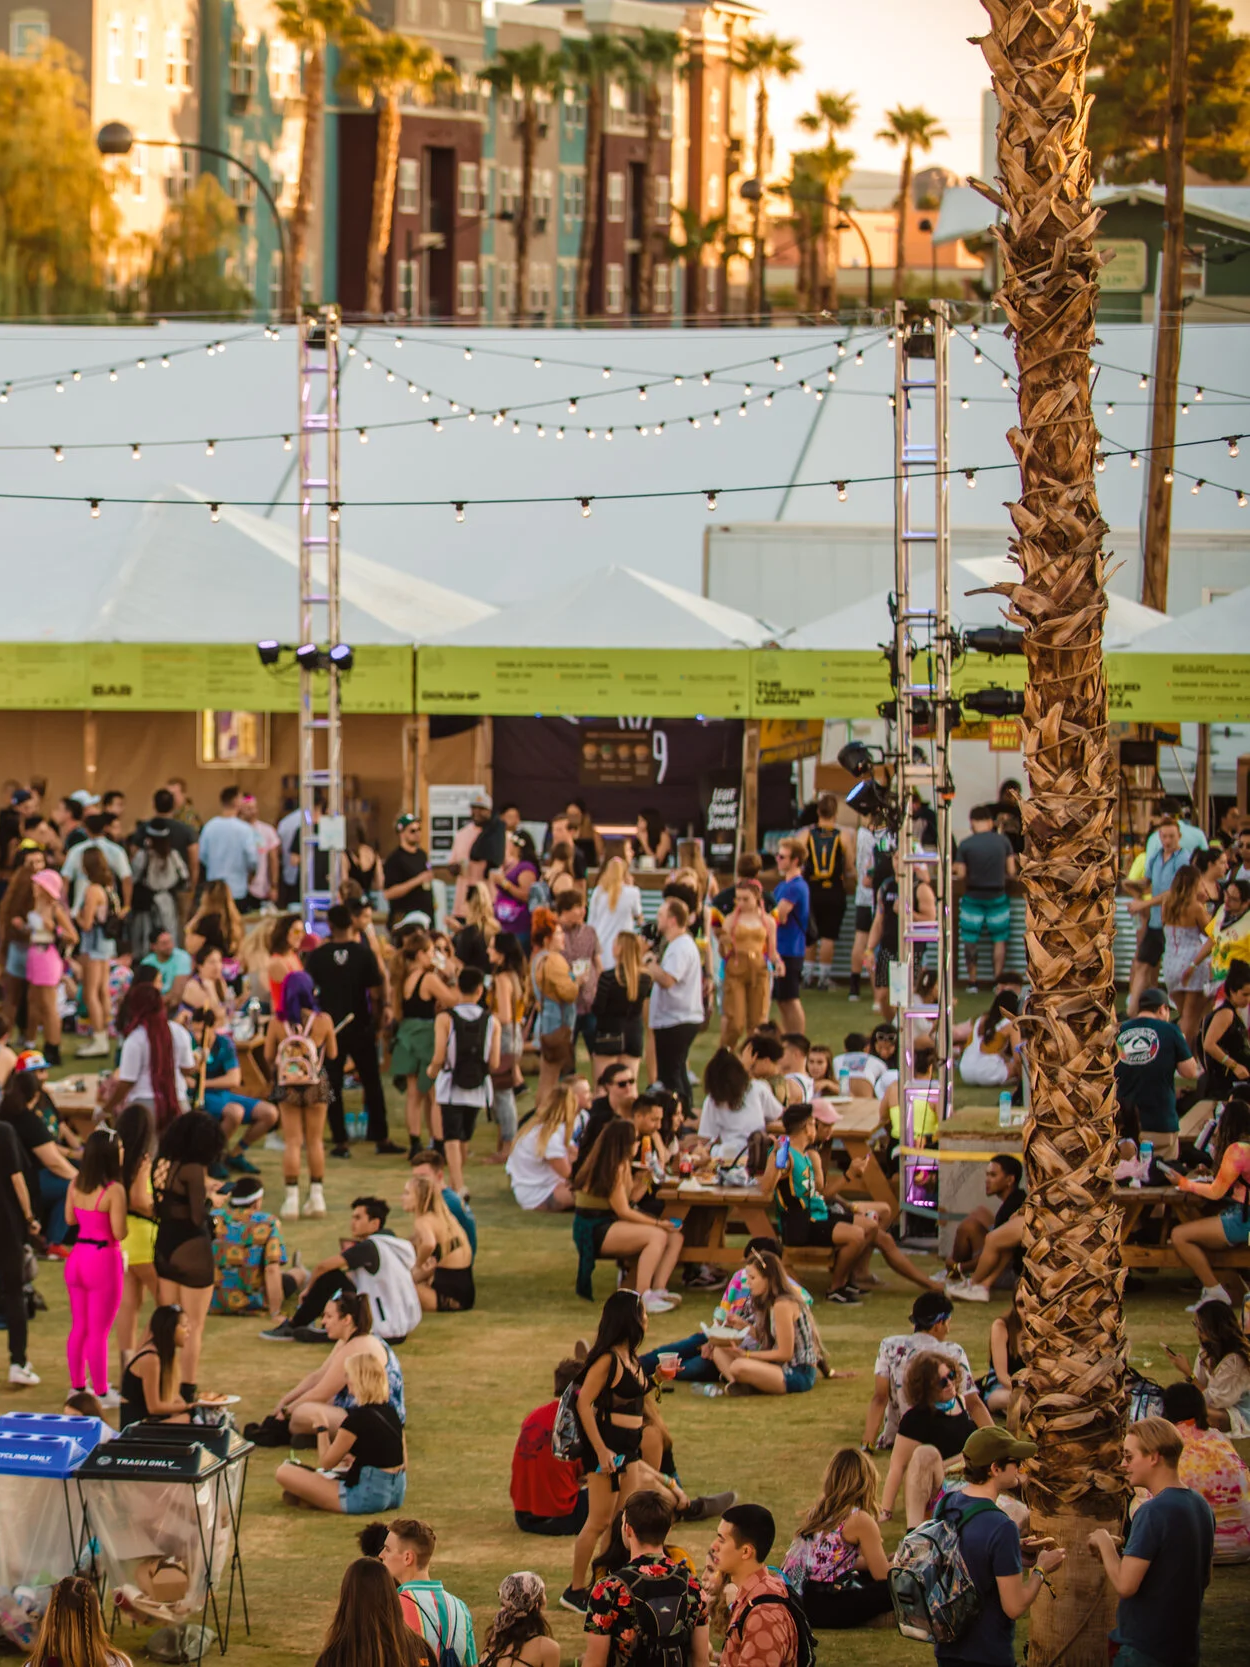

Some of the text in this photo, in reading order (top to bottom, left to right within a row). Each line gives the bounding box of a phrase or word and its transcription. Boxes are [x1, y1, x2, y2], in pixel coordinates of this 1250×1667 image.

[91, 684, 132, 697] BAR
[1107, 683, 1141, 692] AKED
[29, 1454, 53, 1463] ONLY
[116, 1458, 148, 1466] TRASH
